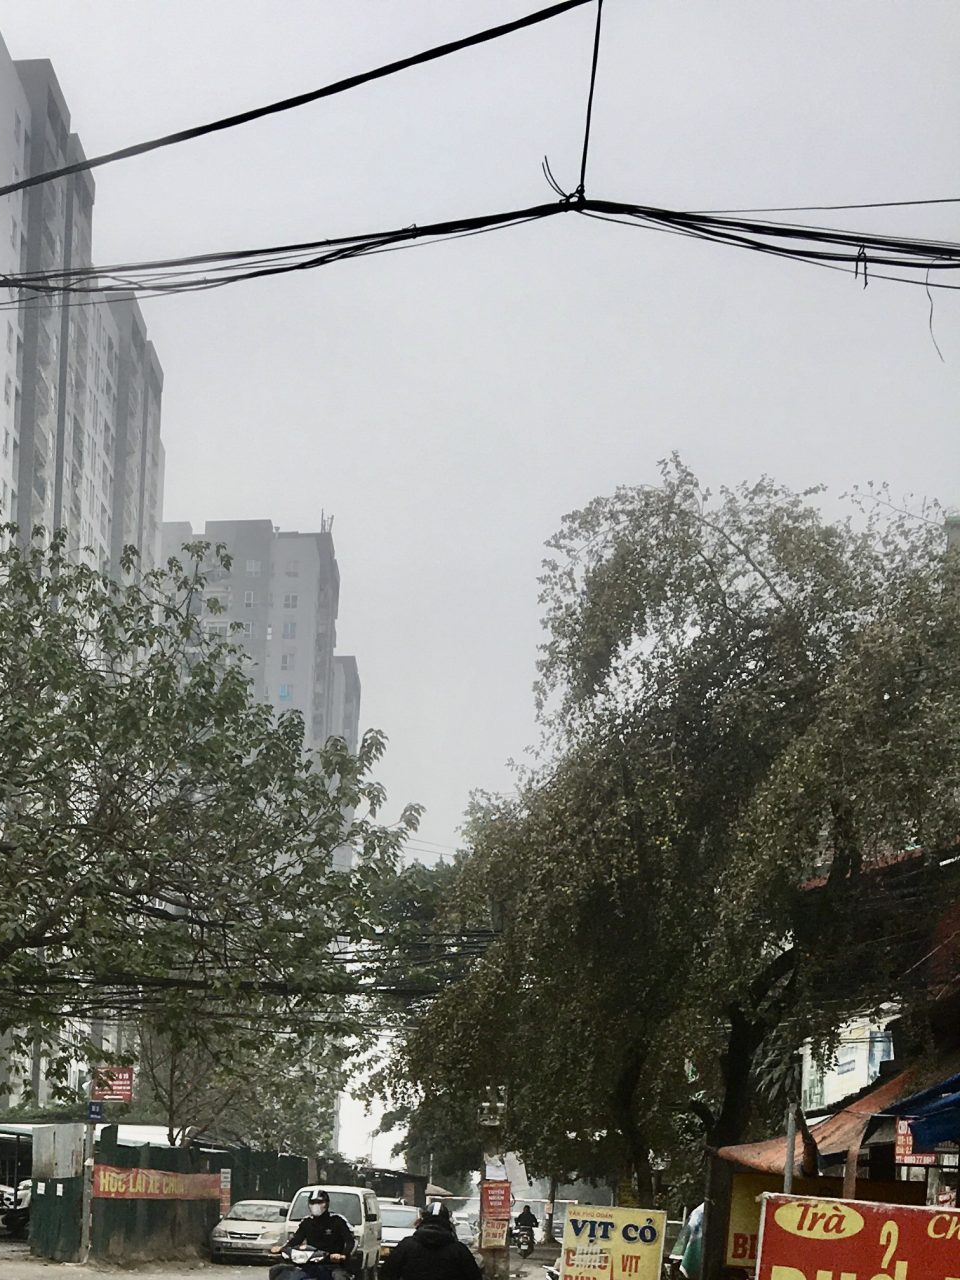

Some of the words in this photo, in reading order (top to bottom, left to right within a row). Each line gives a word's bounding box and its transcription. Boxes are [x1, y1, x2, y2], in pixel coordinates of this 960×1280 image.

[147, 1176, 161, 1194] XE
[569, 1218, 615, 1243] VỊT
[621, 1217, 658, 1243] CỎ
[796, 1202, 847, 1235] Trà
[621, 1254, 641, 1277] VỊT
